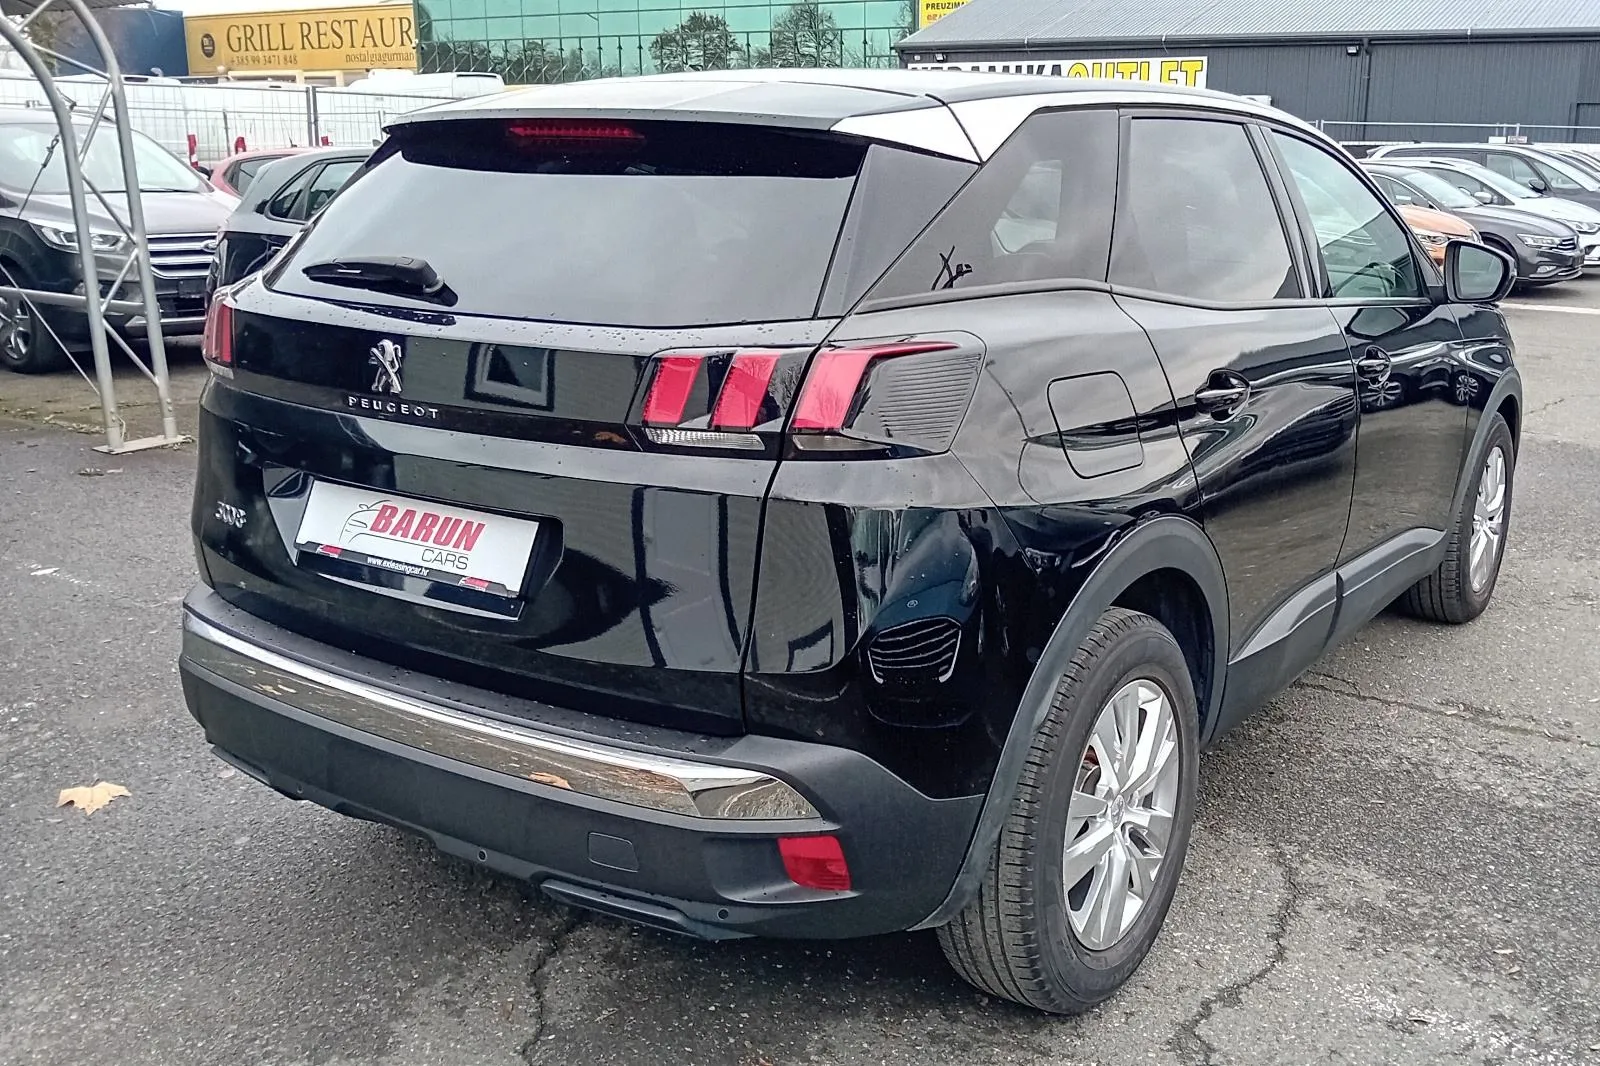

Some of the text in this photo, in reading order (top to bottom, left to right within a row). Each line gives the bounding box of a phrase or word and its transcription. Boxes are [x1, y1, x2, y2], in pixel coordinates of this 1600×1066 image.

[226, 16, 413, 53] GRILL RESTAUR
[231, 56, 248, 66] +385
[348, 396, 438, 419] PEUGEOT
[369, 504, 486, 552] BARUN
[421, 548, 469, 571] CARS
